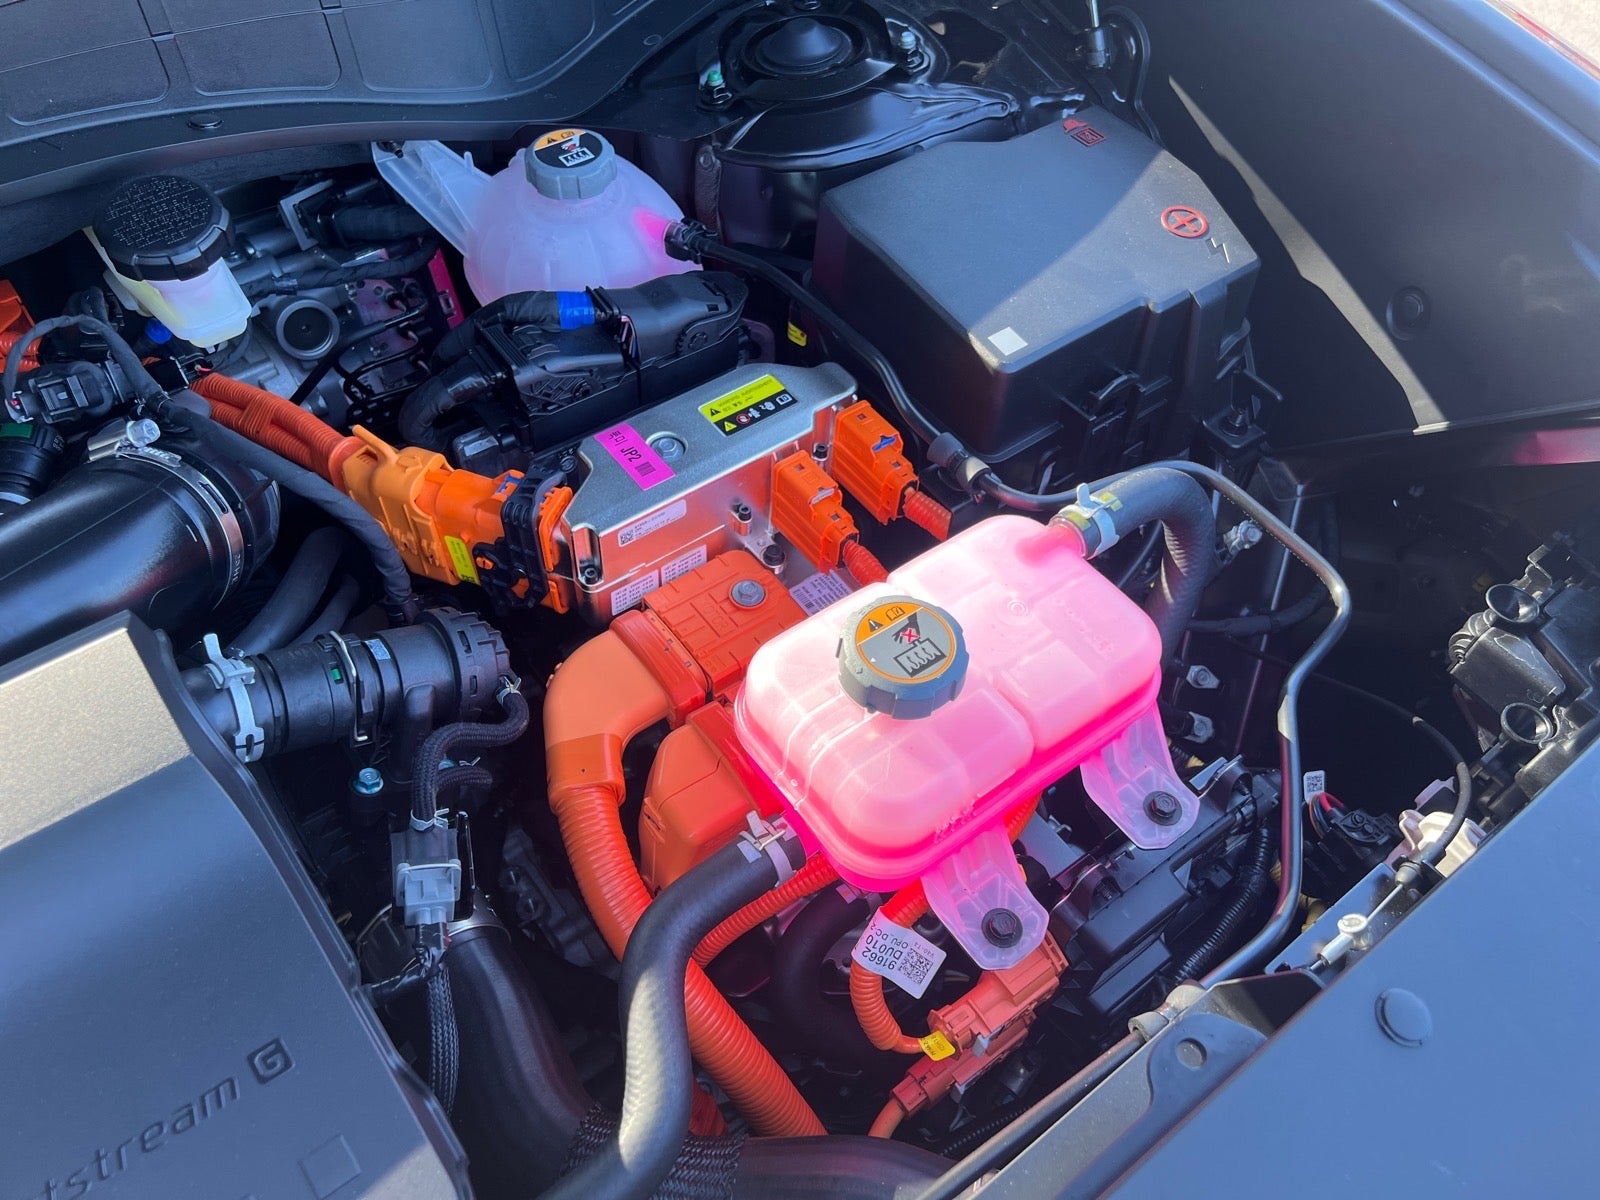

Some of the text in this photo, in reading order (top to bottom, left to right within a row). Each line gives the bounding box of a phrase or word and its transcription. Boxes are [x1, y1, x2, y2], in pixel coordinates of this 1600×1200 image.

[620, 446, 642, 462] JP2
[861, 946, 897, 970] 91662
[865, 934, 903, 960] DU010
[34, 1076, 241, 1200] tstream
